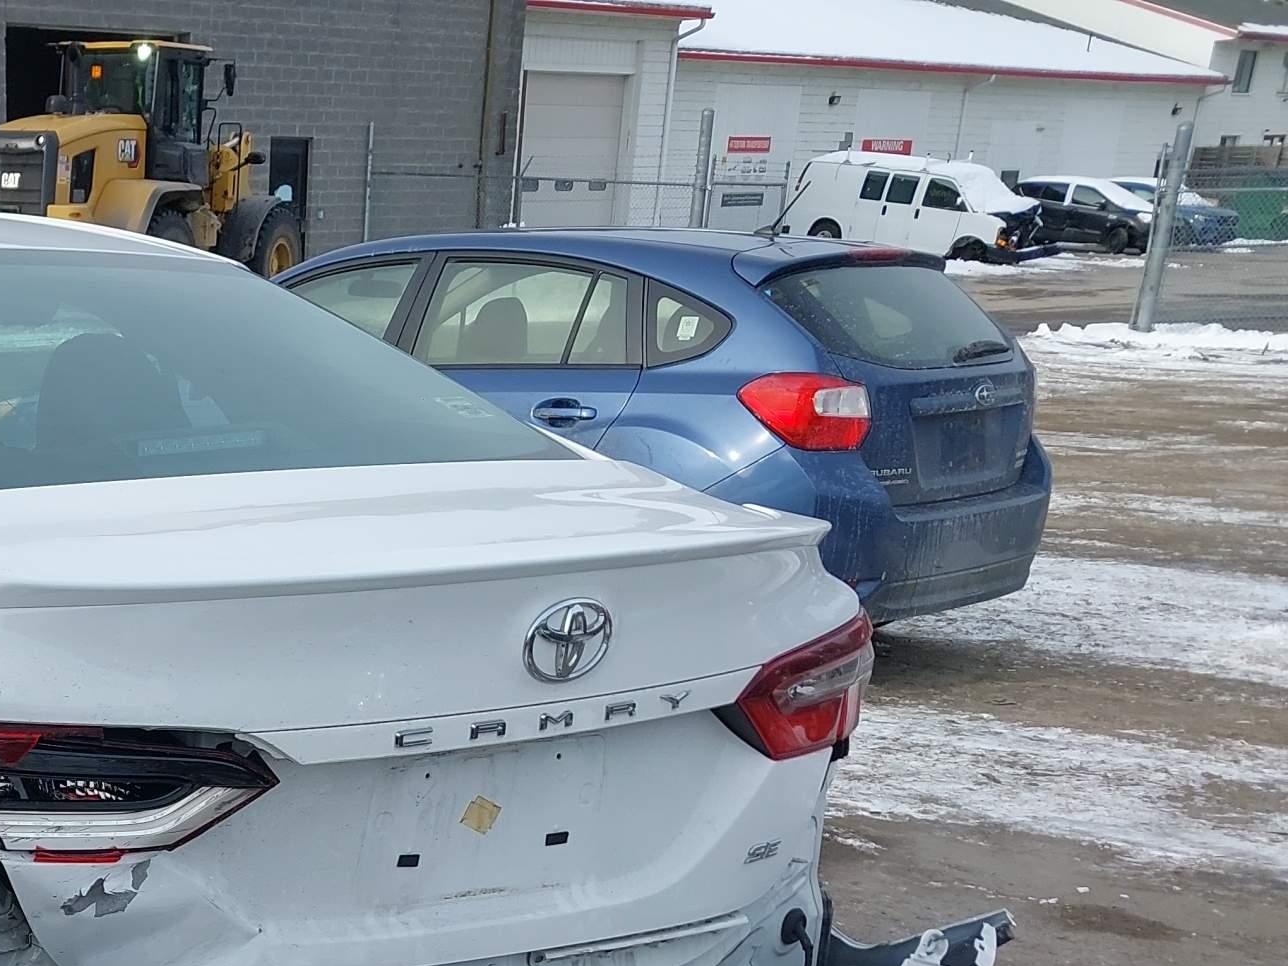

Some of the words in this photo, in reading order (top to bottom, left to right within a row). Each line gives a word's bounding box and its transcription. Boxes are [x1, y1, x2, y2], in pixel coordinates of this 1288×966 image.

[118, 139, 137, 162] CAT
[872, 140, 904, 151] WARNING
[1, 172, 21, 188] CAT
[394, 690, 691, 748] CAMRY
[744, 840, 782, 864] SE
